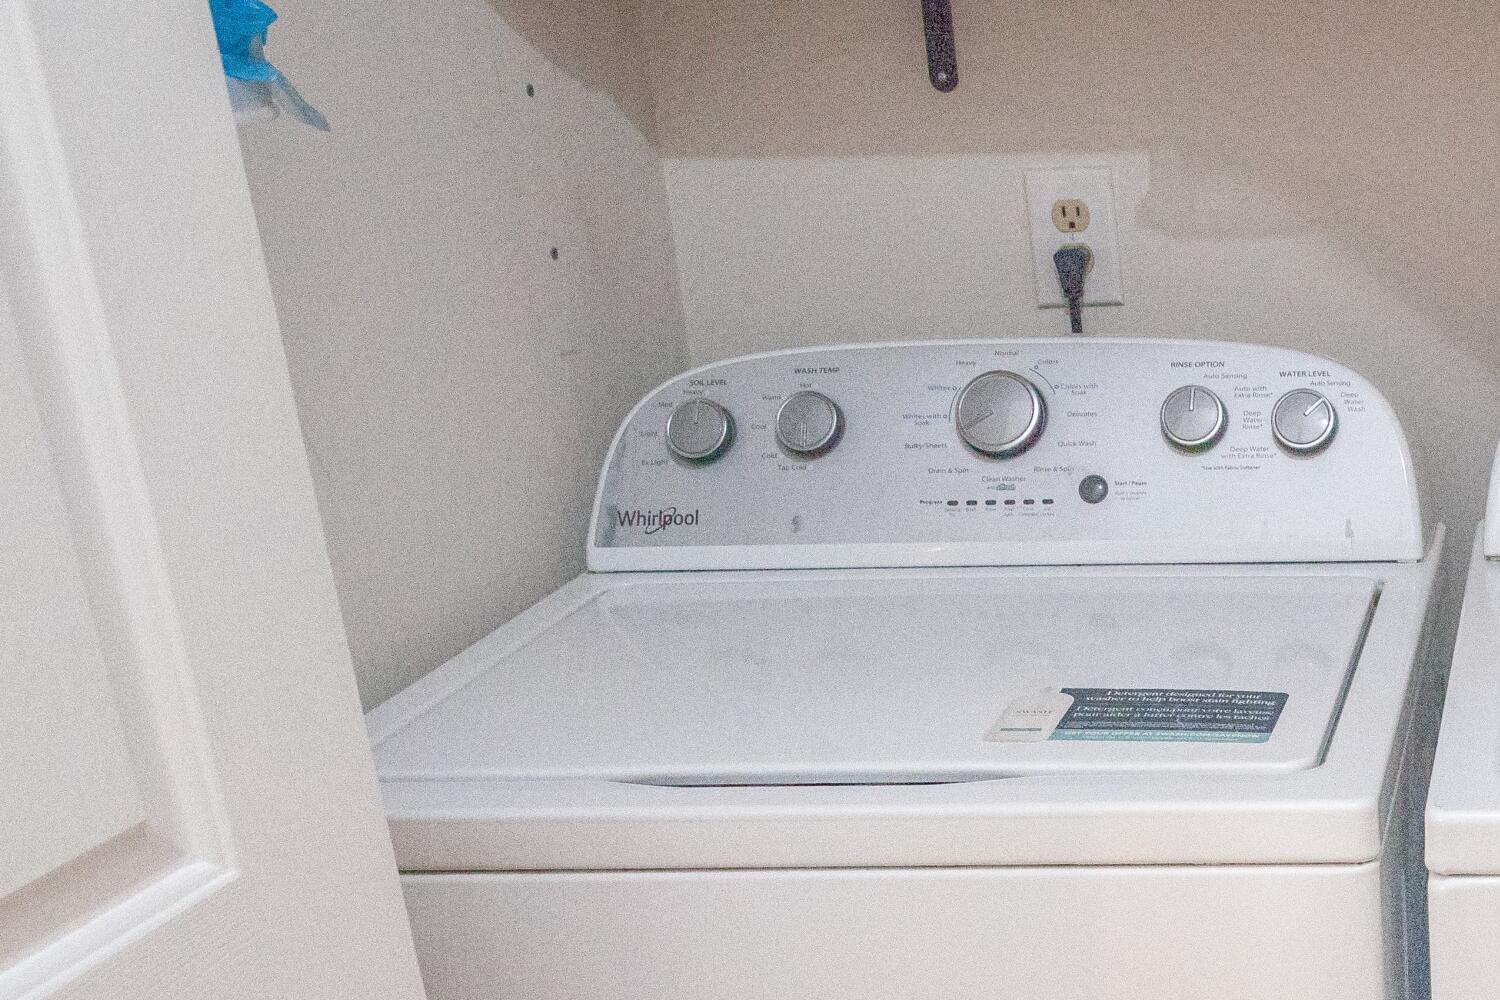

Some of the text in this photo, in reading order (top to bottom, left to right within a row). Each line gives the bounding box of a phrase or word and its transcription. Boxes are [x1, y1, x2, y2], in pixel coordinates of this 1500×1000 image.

[688, 379, 705, 387] SOIL
[617, 507, 699, 535] Whirlpool
[1106, 690, 1163, 698] Detergent
[1165, 691, 1216, 699] designed
